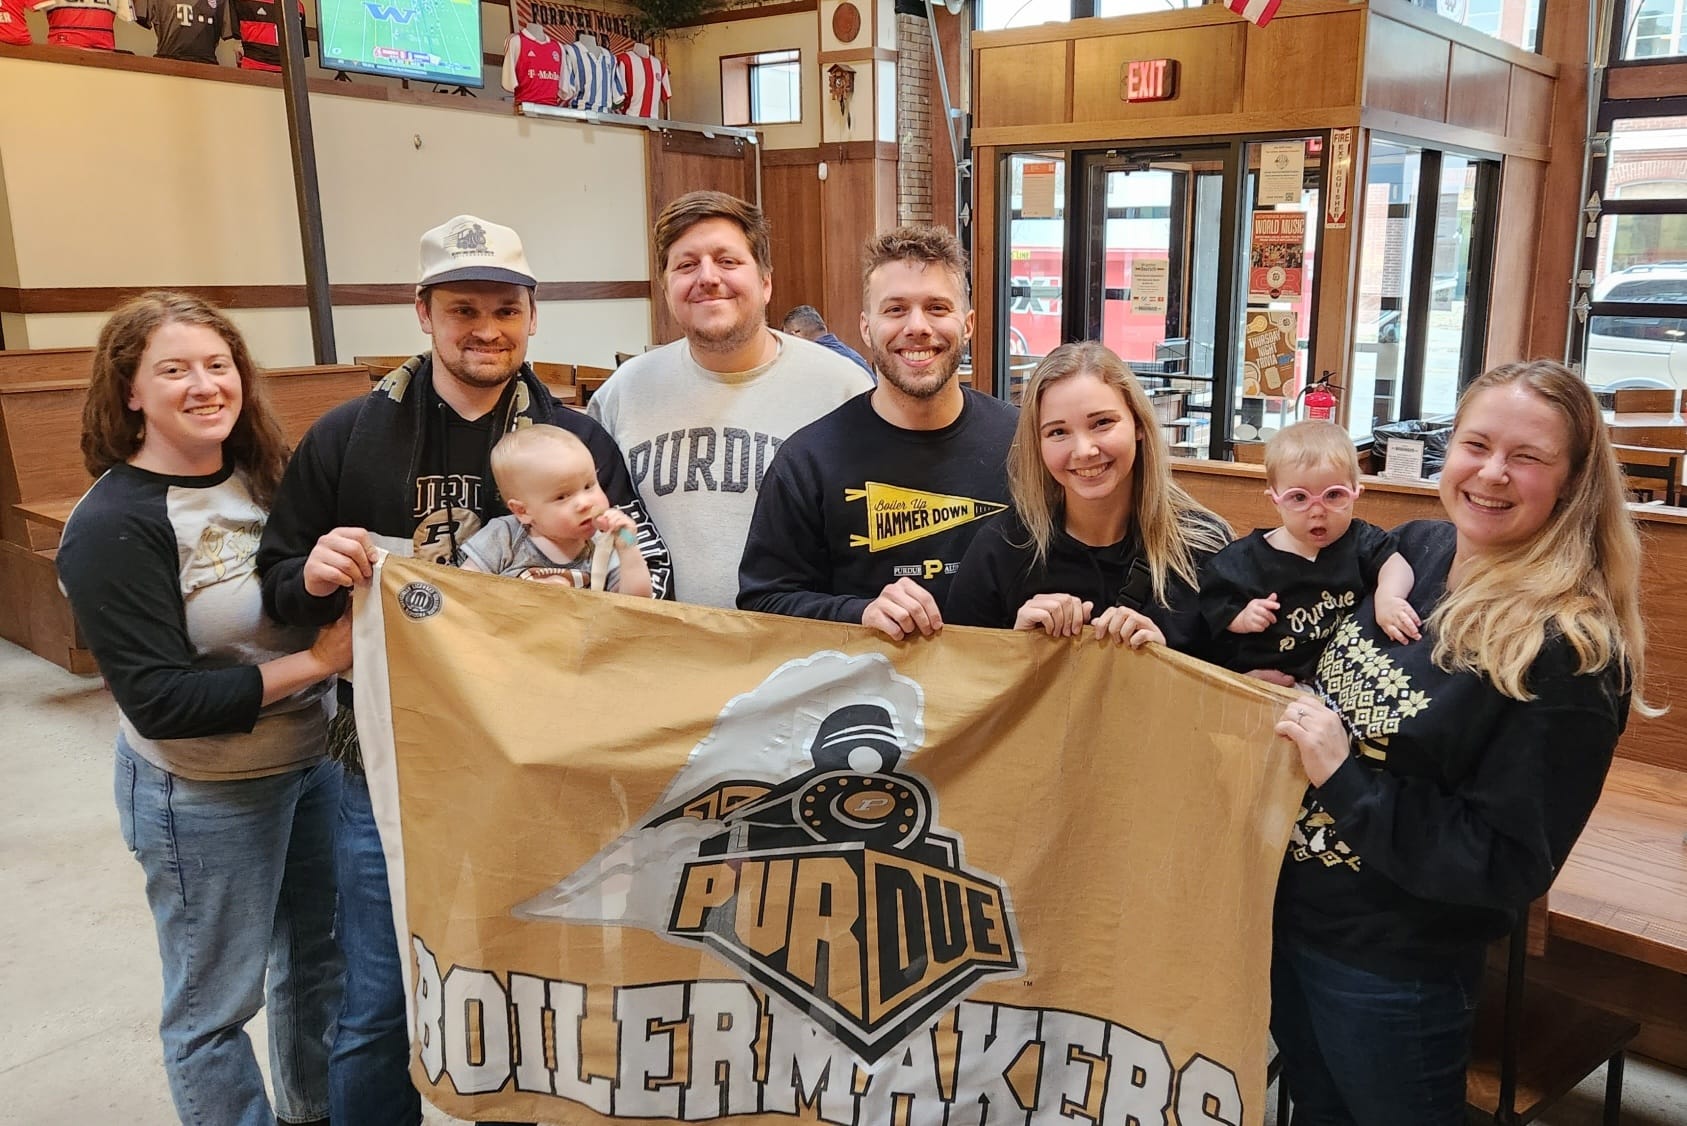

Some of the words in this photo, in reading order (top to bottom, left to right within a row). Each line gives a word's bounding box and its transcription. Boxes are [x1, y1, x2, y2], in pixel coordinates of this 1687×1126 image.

[531, 3, 591, 28] FOREVER
[1128, 60, 1167, 99] EXIT
[1334, 133, 1350, 143] FIRE
[1255, 219, 1280, 235] WORLD
[1281, 219, 1305, 235] MUSIC
[1248, 330, 1281, 349] THURSDAY
[1258, 342, 1277, 358] NIGHT
[1256, 353, 1278, 369] TRIVIA
[628, 427, 785, 497] PURDU
[874, 500, 907, 512] Boiler
[911, 499, 927, 516] Up
[876, 509, 930, 541] HAMMER
[933, 505, 969, 525] DOWN
[923, 560, 943, 579] P
[1287, 589, 1355, 633] Purdue
[853, 798, 890, 812] P
[676, 857, 1003, 1021] PURDUE
[412, 934, 1244, 1126] BOILERMAKERS
